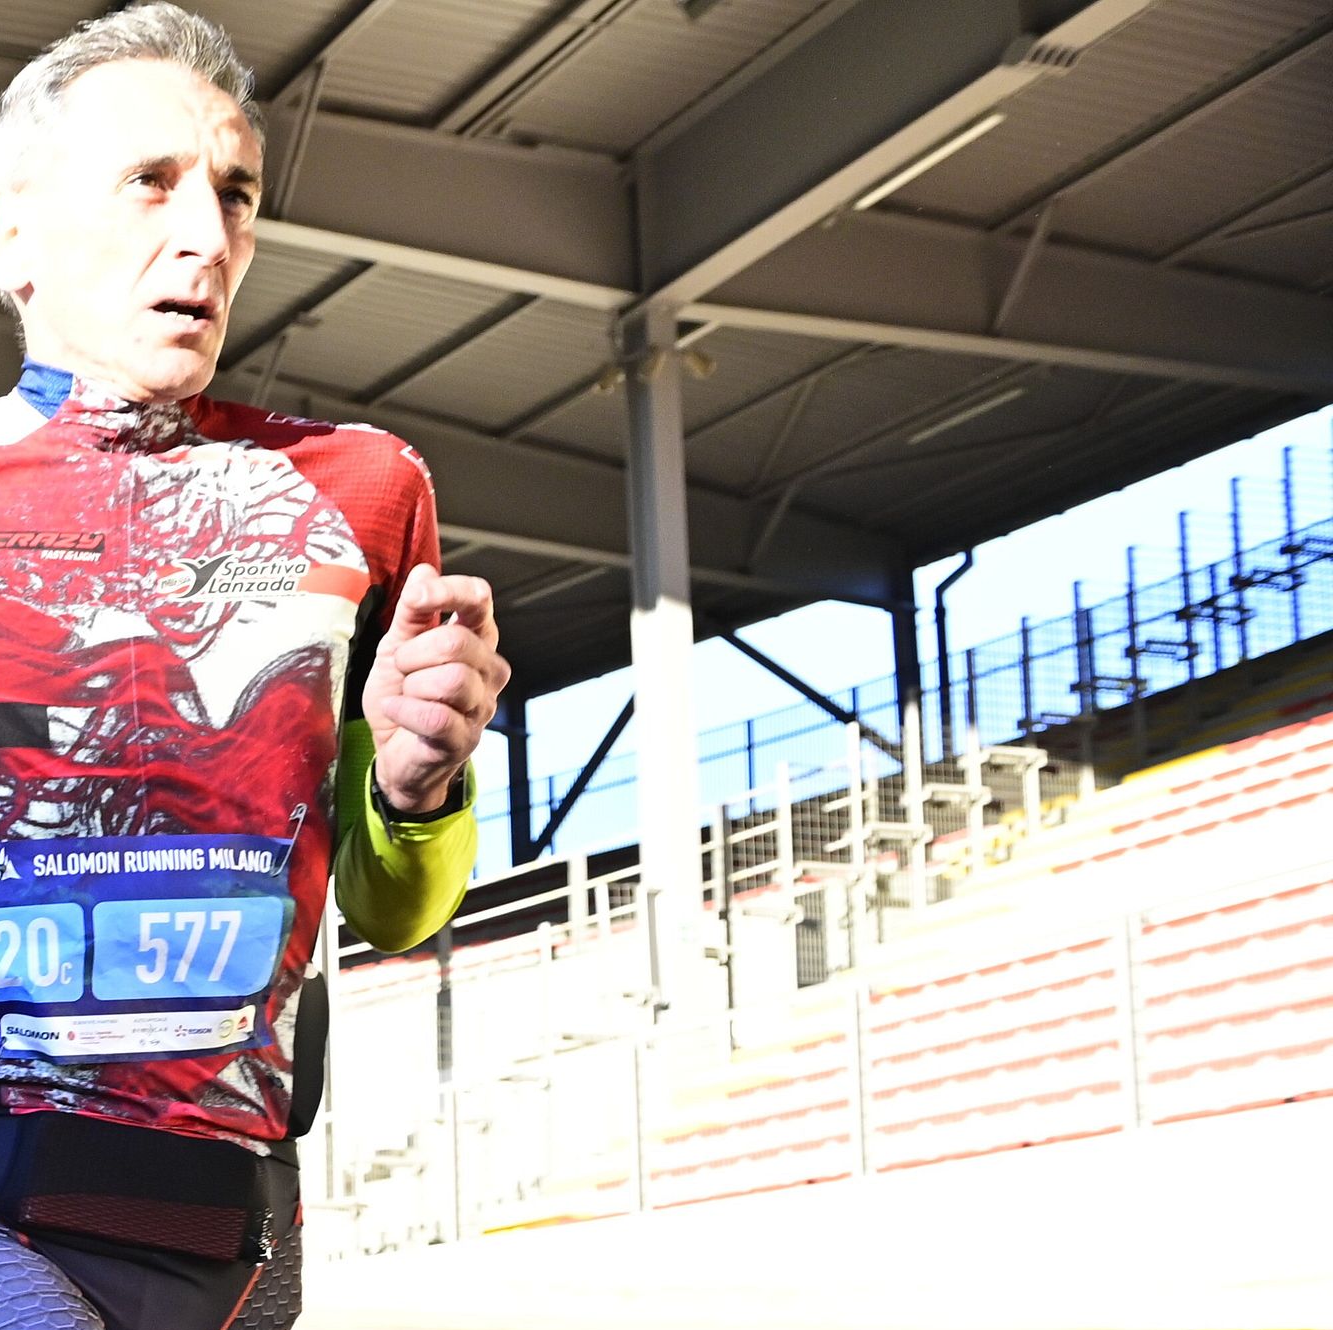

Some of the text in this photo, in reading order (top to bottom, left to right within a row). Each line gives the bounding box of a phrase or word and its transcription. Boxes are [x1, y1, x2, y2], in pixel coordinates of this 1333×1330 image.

[219, 560, 307, 580] Sportiva
[208, 576, 296, 595] Lanzada
[33, 848, 273, 876] SALOMON RUNNING MILANO
[135, 910, 242, 984] 577
[6, 1026, 60, 1041] SALOMON
